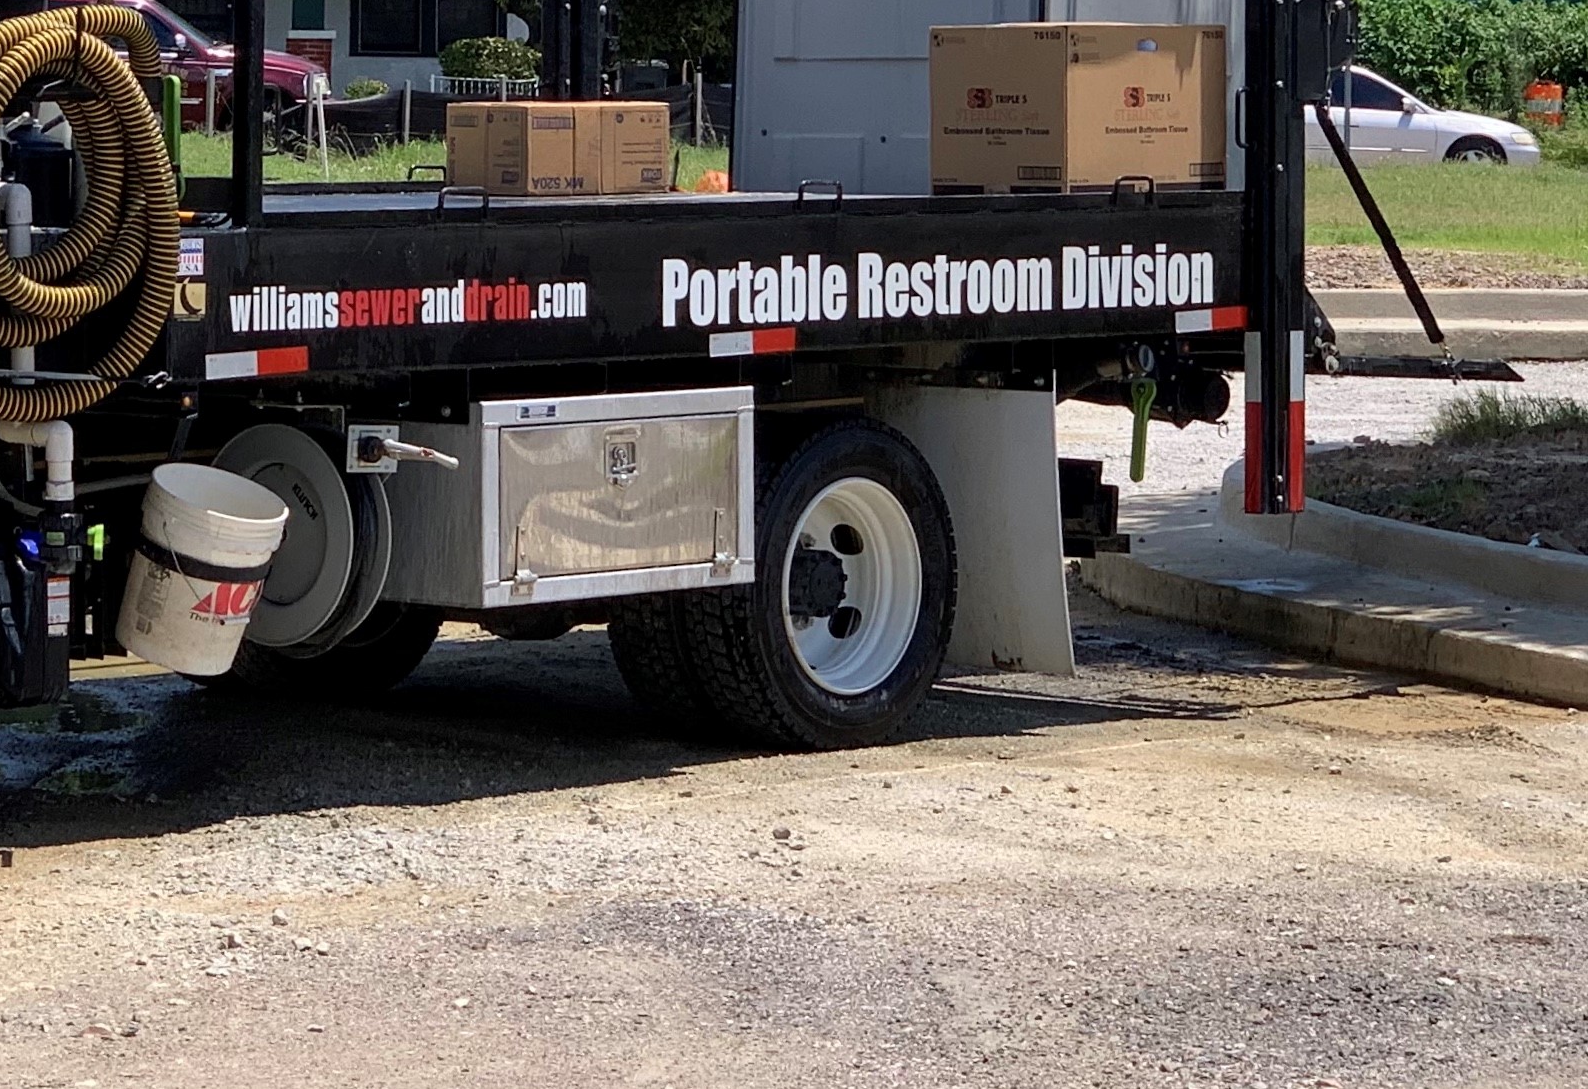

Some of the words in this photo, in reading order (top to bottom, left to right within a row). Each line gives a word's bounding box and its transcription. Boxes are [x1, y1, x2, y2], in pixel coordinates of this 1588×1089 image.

[995, 95, 1020, 104] TRIPLE
[1022, 95, 1028, 104] S
[1146, 93, 1165, 103] TRIPLE
[1105, 126, 1138, 134] Embossed
[1139, 125, 1168, 134] Bathroom
[1169, 125, 1189, 133] Tissue
[532, 176, 561, 190] 520A
[564, 176, 584, 189] MK
[661, 255, 848, 328] Portable
[857, 252, 1053, 320] Restroom
[1061, 244, 1214, 310] Division
[229, 277, 587, 332] williamsseweranddrain.com
[189, 612, 209, 623] The
